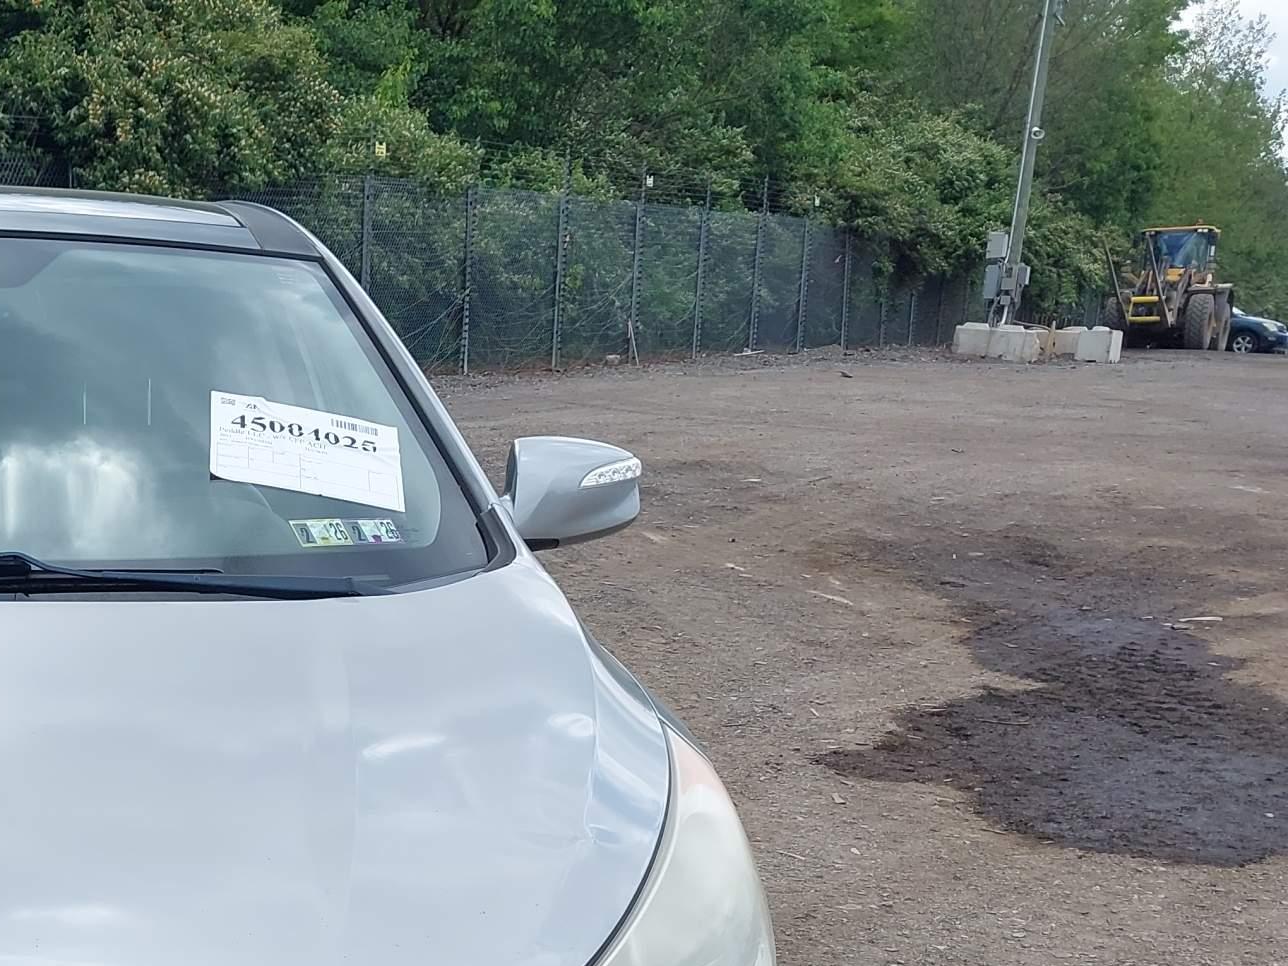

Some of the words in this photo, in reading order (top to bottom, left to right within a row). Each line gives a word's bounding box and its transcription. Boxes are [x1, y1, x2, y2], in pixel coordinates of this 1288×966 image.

[300, 527, 315, 544] 2
[329, 522, 349, 541] 26
[351, 525, 367, 542] 2
